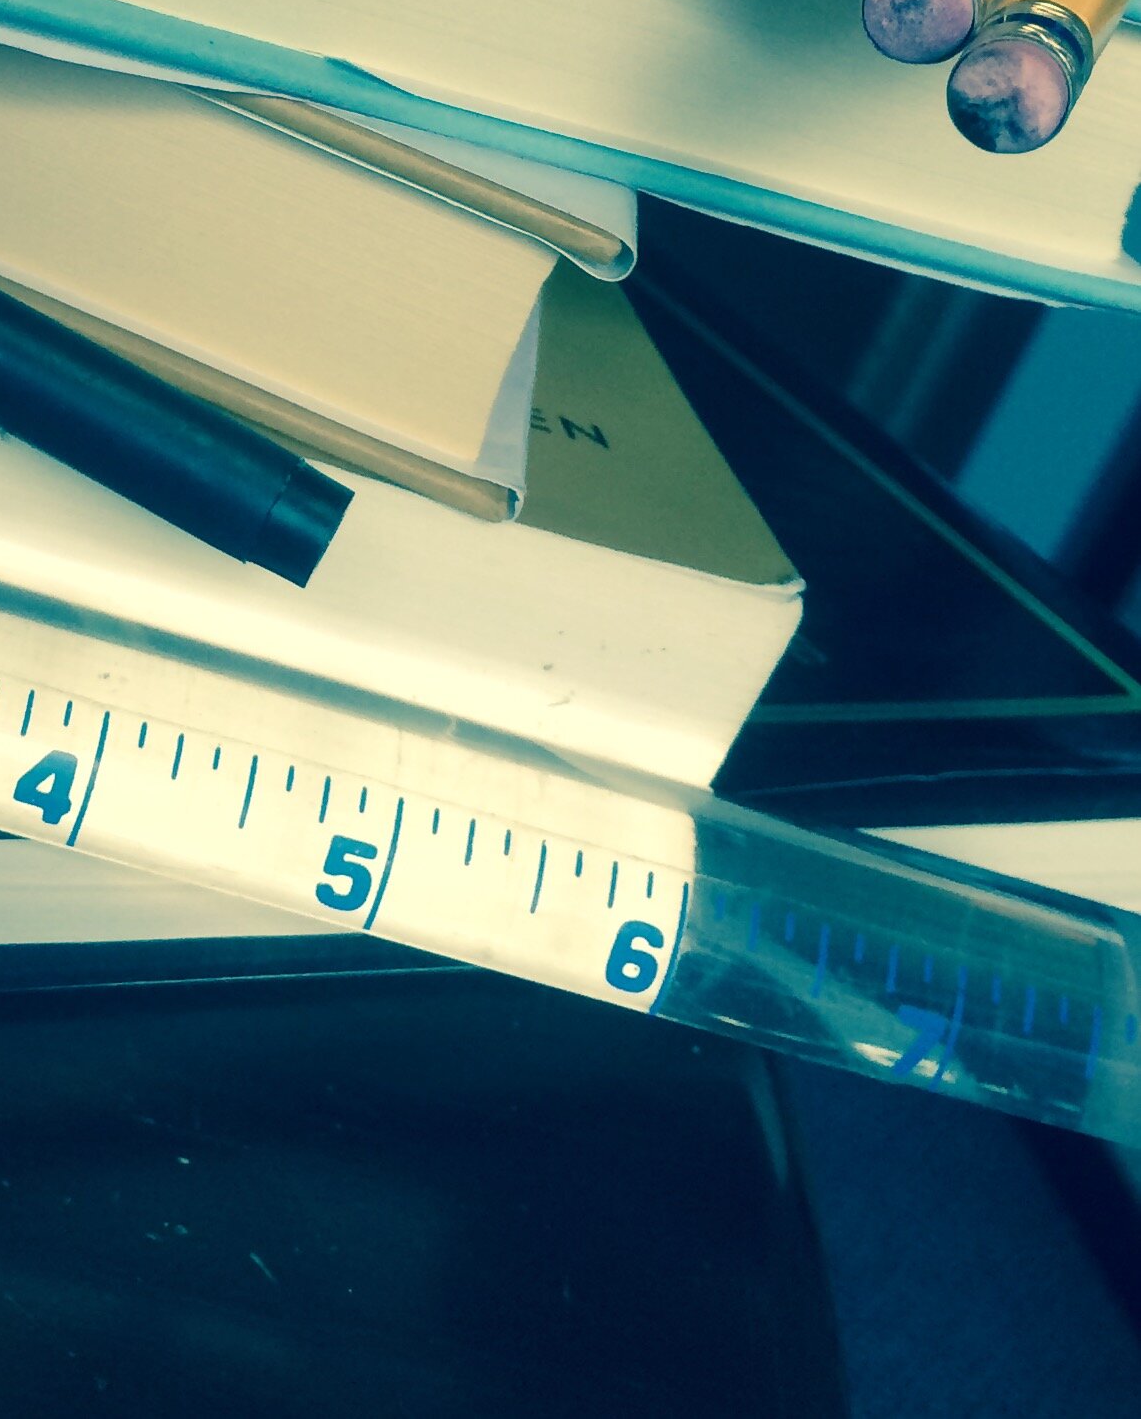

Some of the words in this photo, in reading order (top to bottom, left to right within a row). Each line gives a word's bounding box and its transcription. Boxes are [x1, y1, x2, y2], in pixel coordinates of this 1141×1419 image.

[13, 752, 77, 824] 4
[315, 835, 378, 912] 5
[605, 920, 664, 994] 6
[893, 1003, 949, 1078] 7
